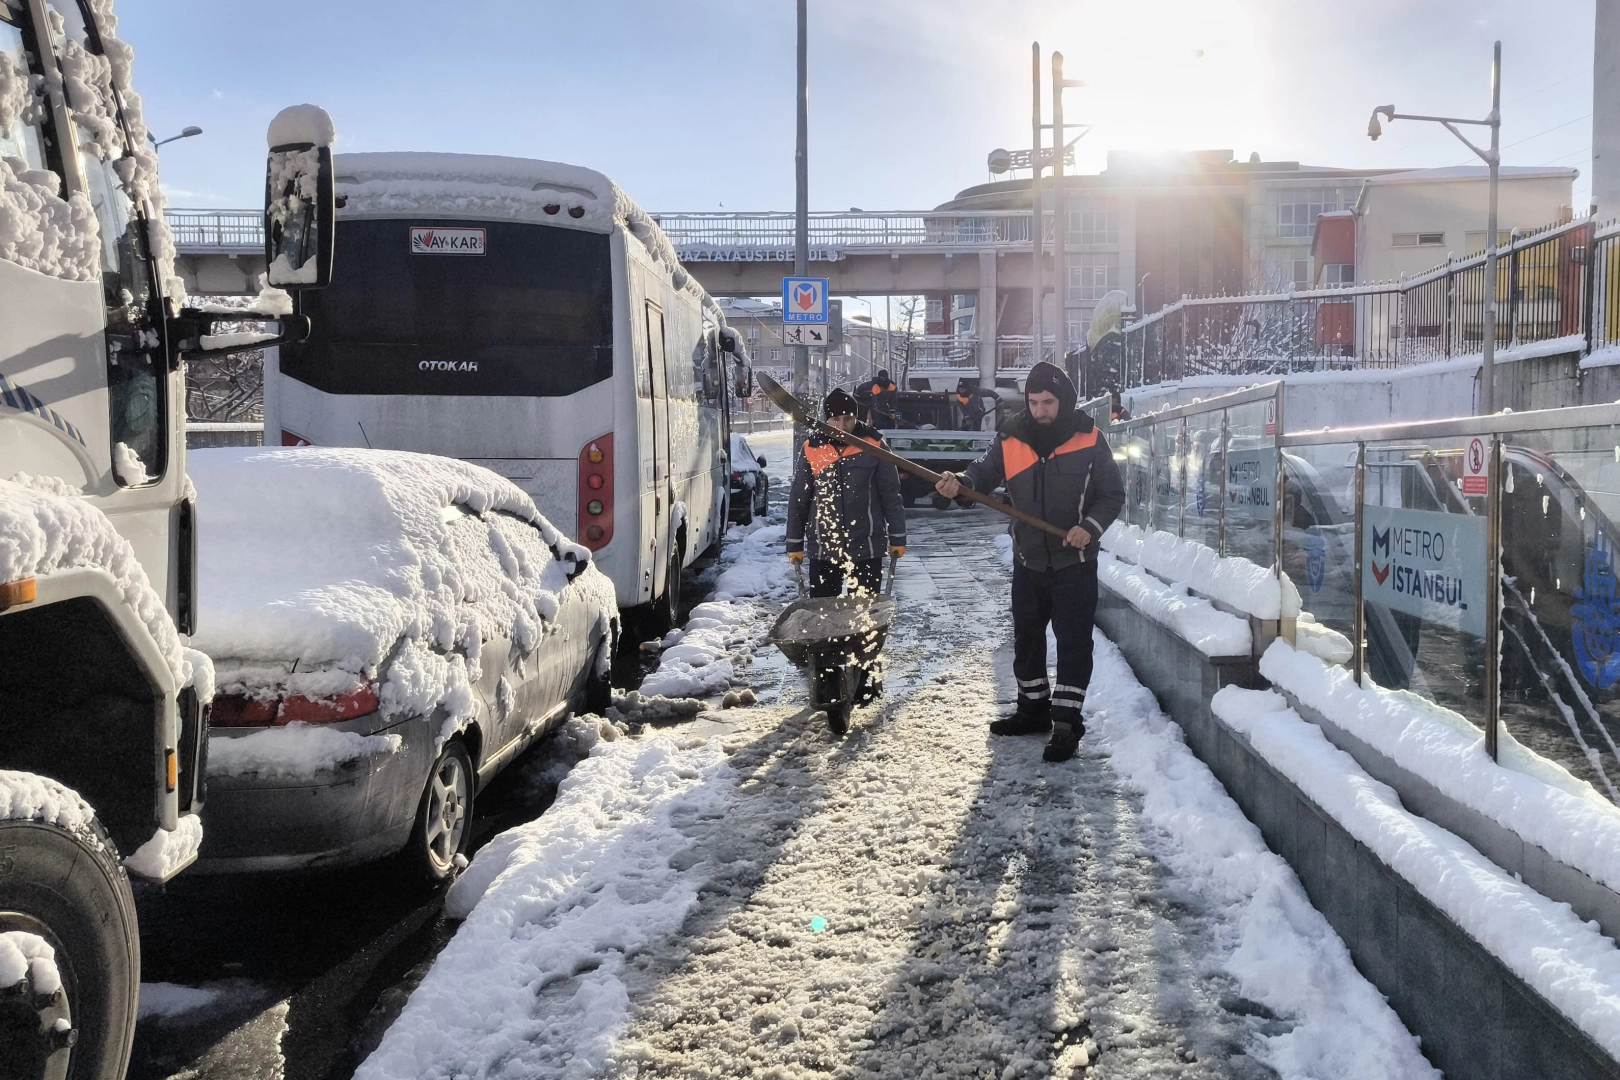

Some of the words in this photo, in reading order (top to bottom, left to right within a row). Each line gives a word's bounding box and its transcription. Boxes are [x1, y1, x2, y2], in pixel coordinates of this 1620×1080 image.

[706, 250, 742, 262] YAYA
[788, 313, 823, 321] METRO
[418, 360, 479, 371] OTOKAR
[1393, 526, 1445, 562] METRO
[1392, 558, 1468, 610] İSTANBUL
